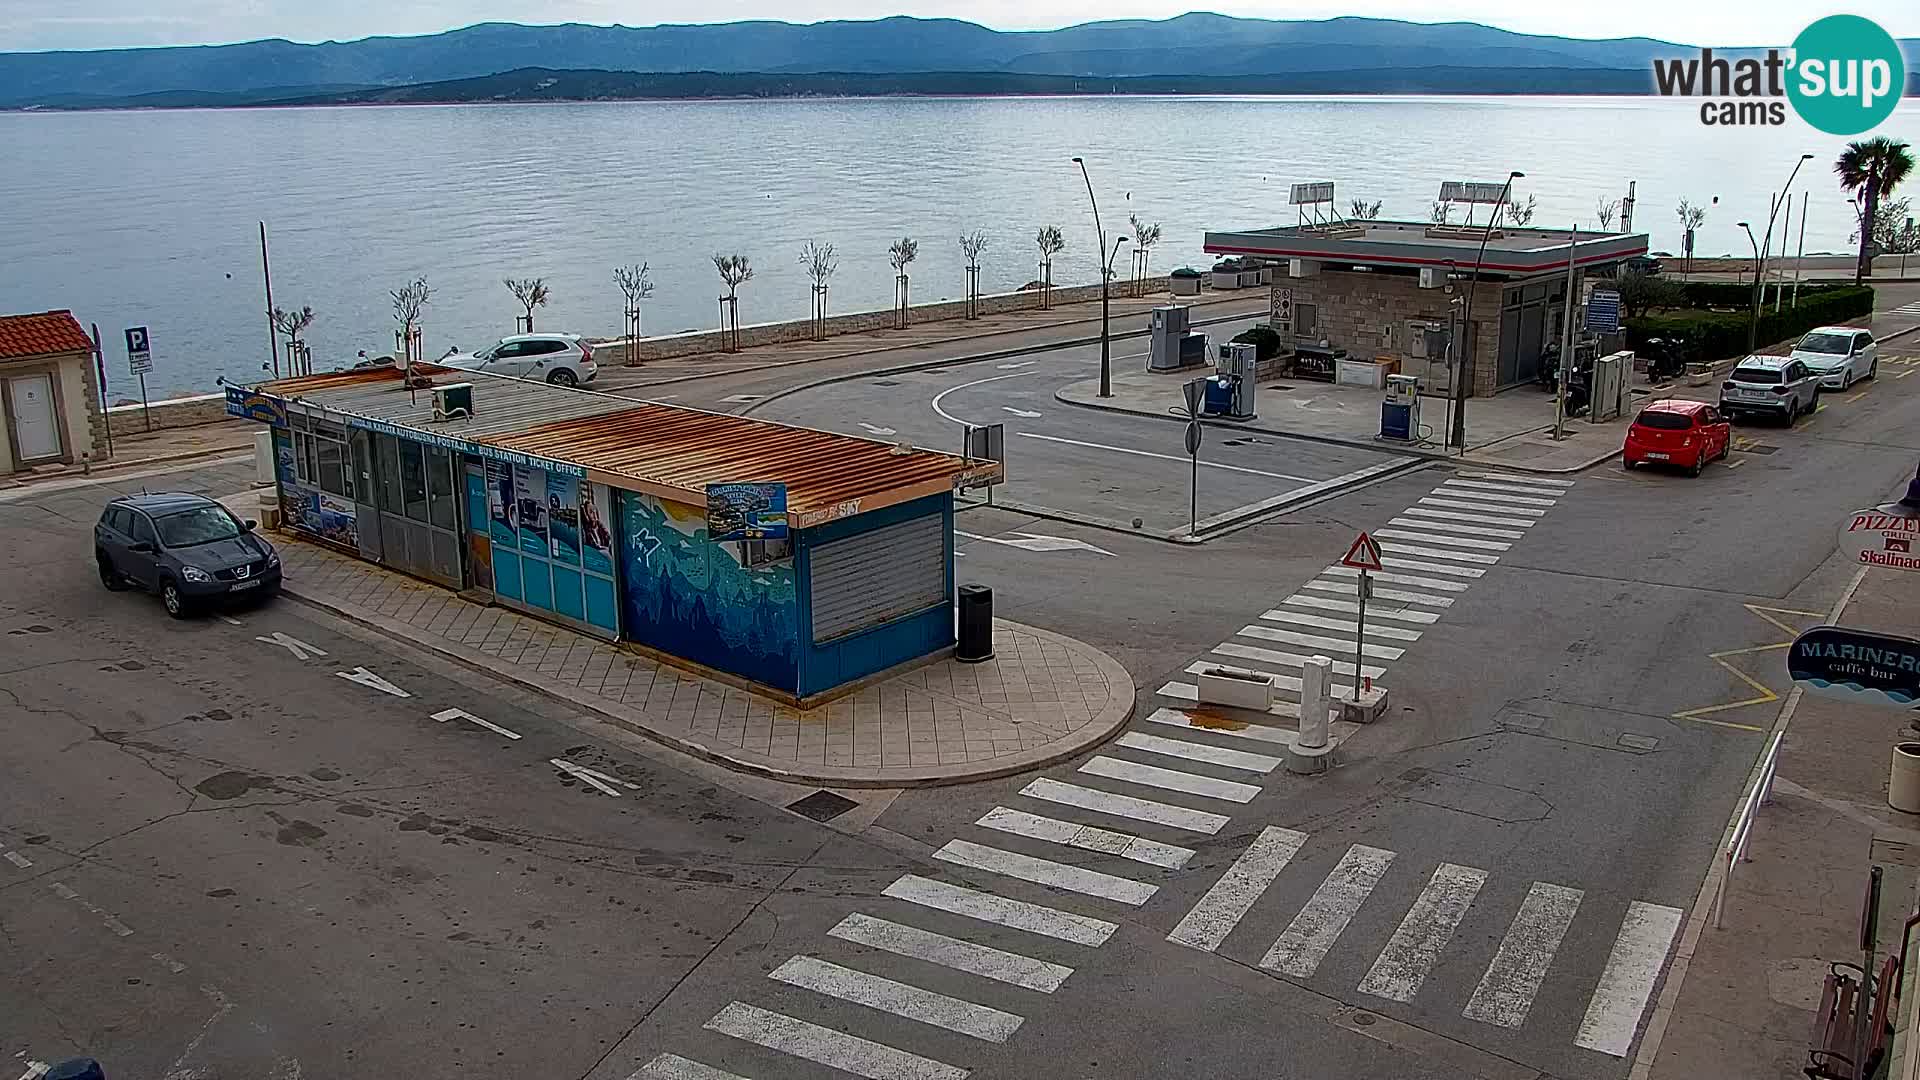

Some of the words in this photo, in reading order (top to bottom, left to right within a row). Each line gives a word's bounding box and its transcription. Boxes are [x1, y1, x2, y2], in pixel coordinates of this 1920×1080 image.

[130, 331, 143, 349] P
[437, 437, 469, 452] POSTAJA
[478, 445, 494, 457] BUS
[494, 450, 526, 465] STATION
[528, 456, 555, 471] TICKET
[555, 462, 583, 477] OFFICE
[1848, 515, 1920, 534] PIZZE
[1881, 530, 1918, 541] GRILL
[1829, 663, 1866, 675] caffe
[1870, 666, 1897, 680] bar
